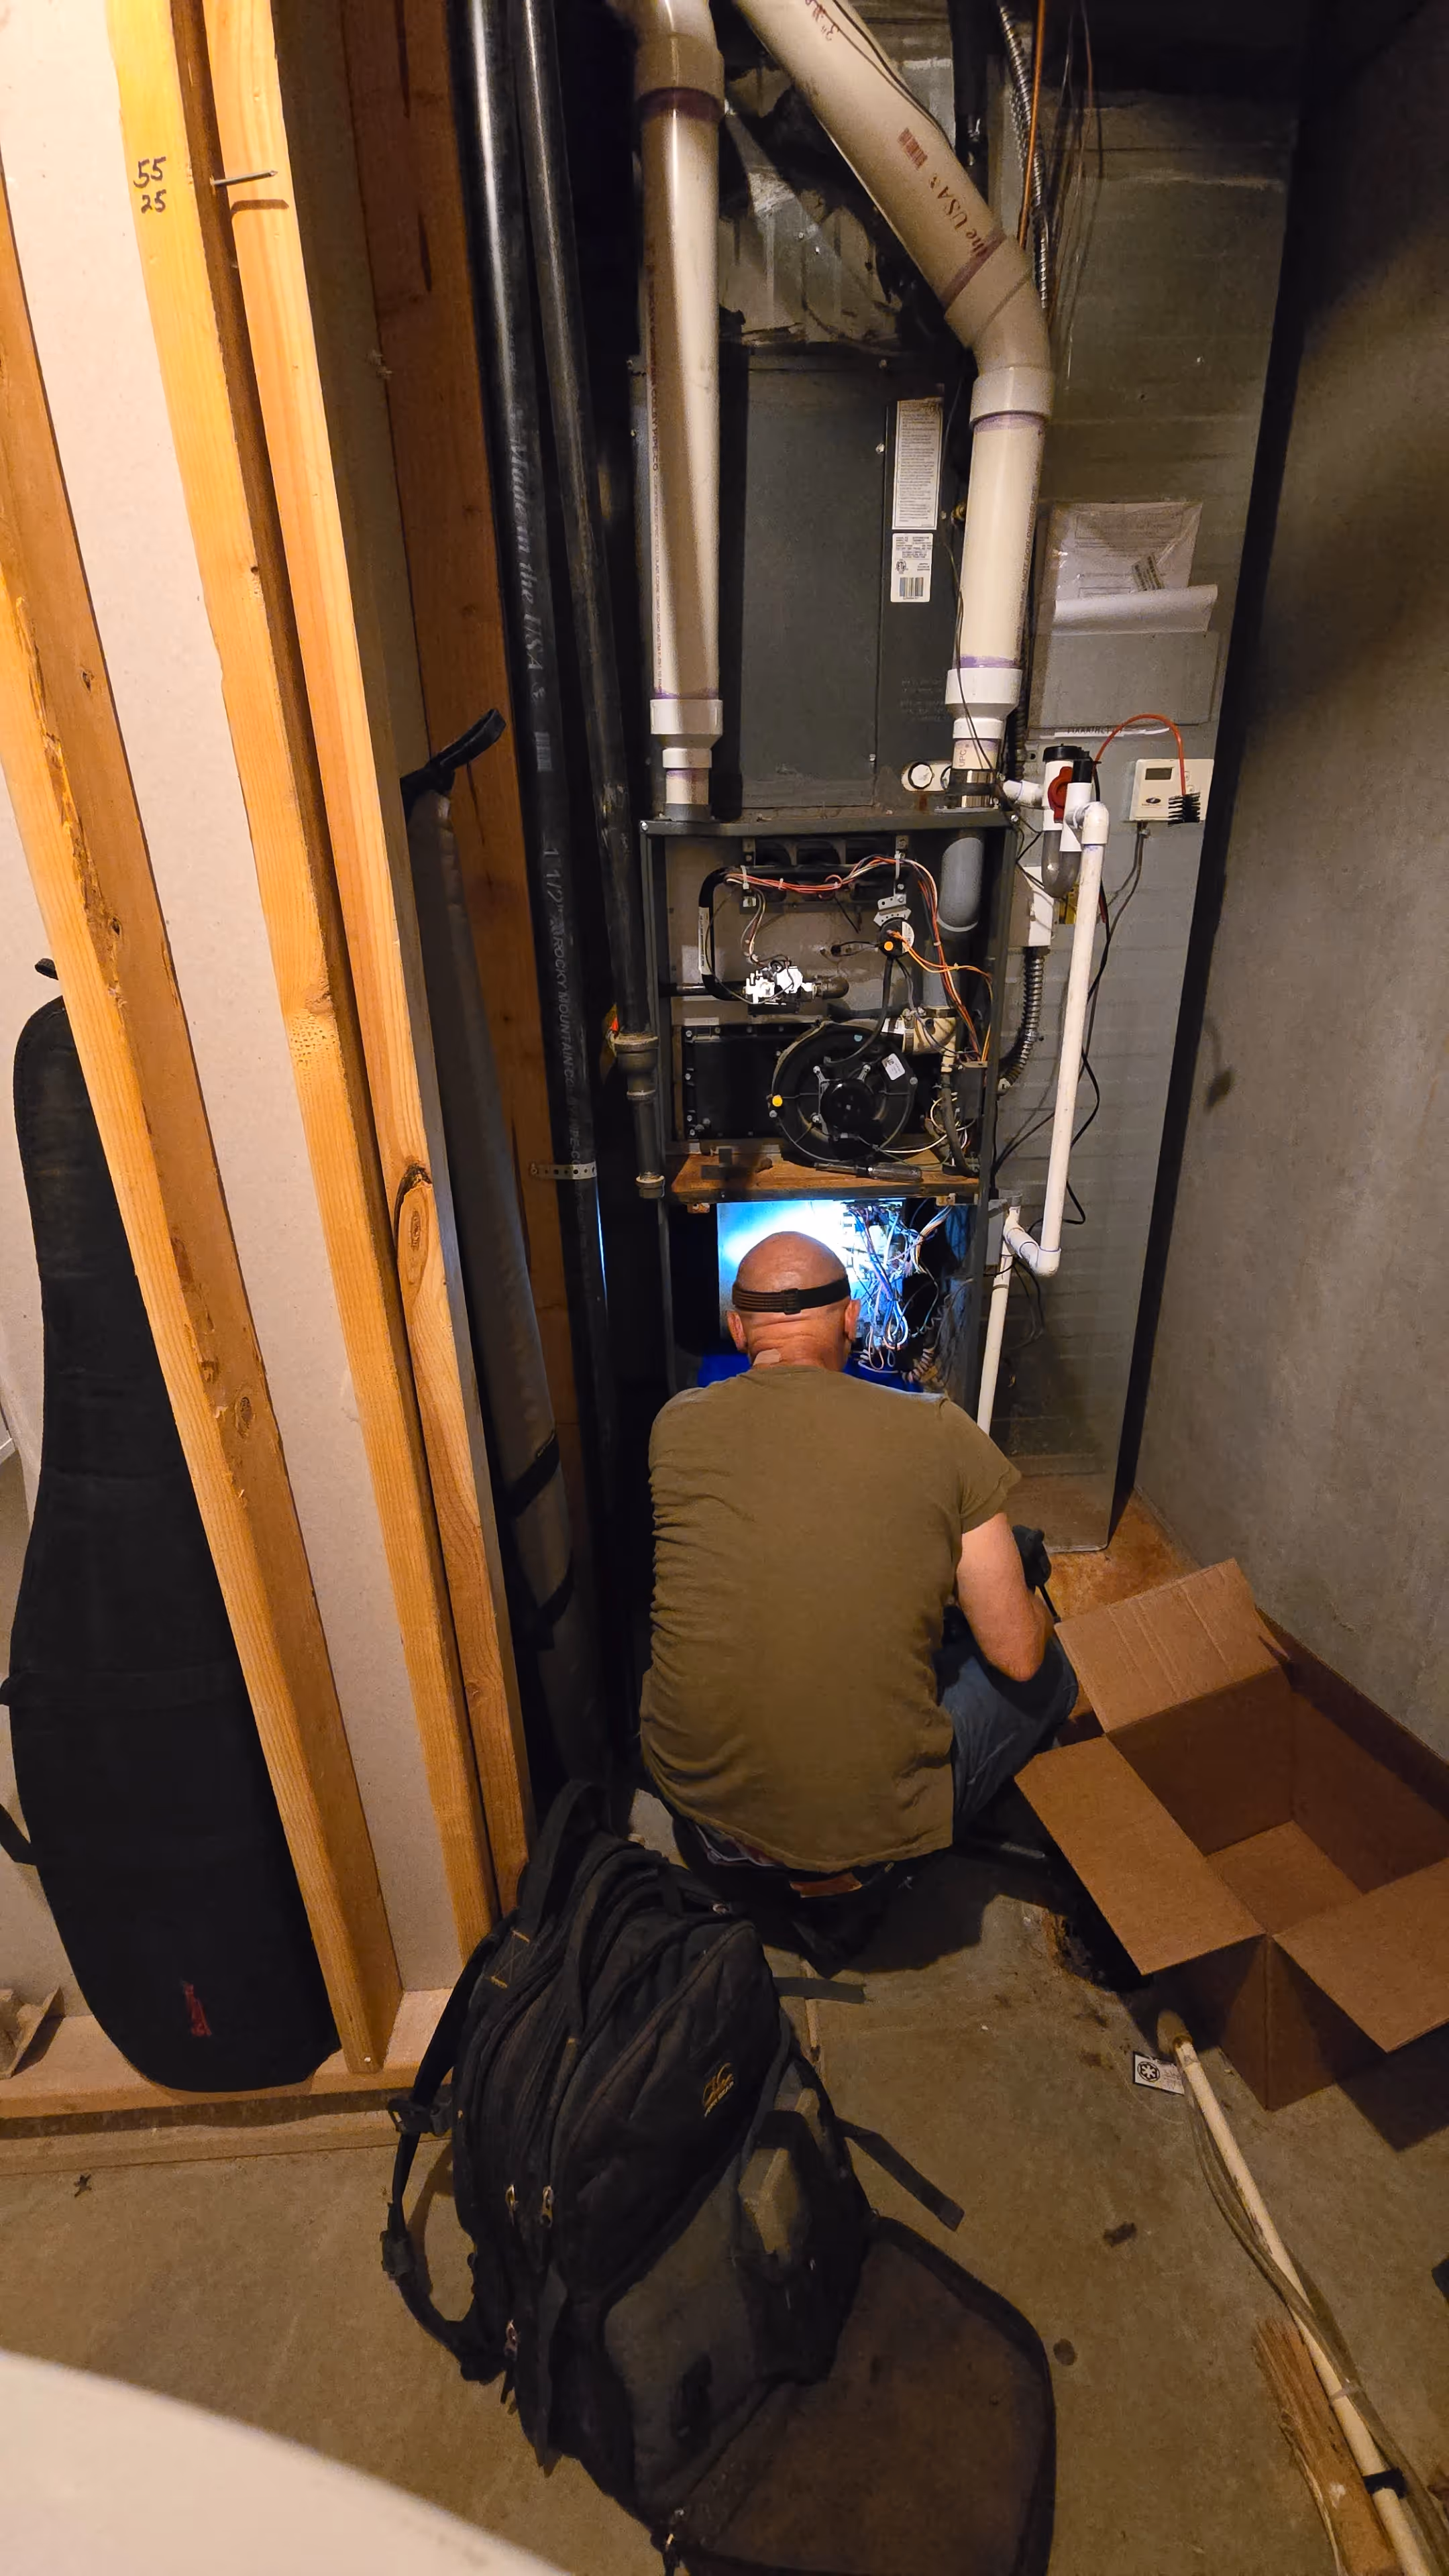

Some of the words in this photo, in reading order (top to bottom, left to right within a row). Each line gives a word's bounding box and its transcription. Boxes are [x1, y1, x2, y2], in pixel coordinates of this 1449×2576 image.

[133, 156, 166, 189] 55
[141, 189, 167, 214] 25
[937, 186, 967, 230] USA
[520, 562, 537, 604] the
[524, 614, 543, 670] USA
[958, 749, 967, 767] UPC
[553, 936, 567, 991] ROCKY
[558, 991, 574, 1068] MOUNTAIN
